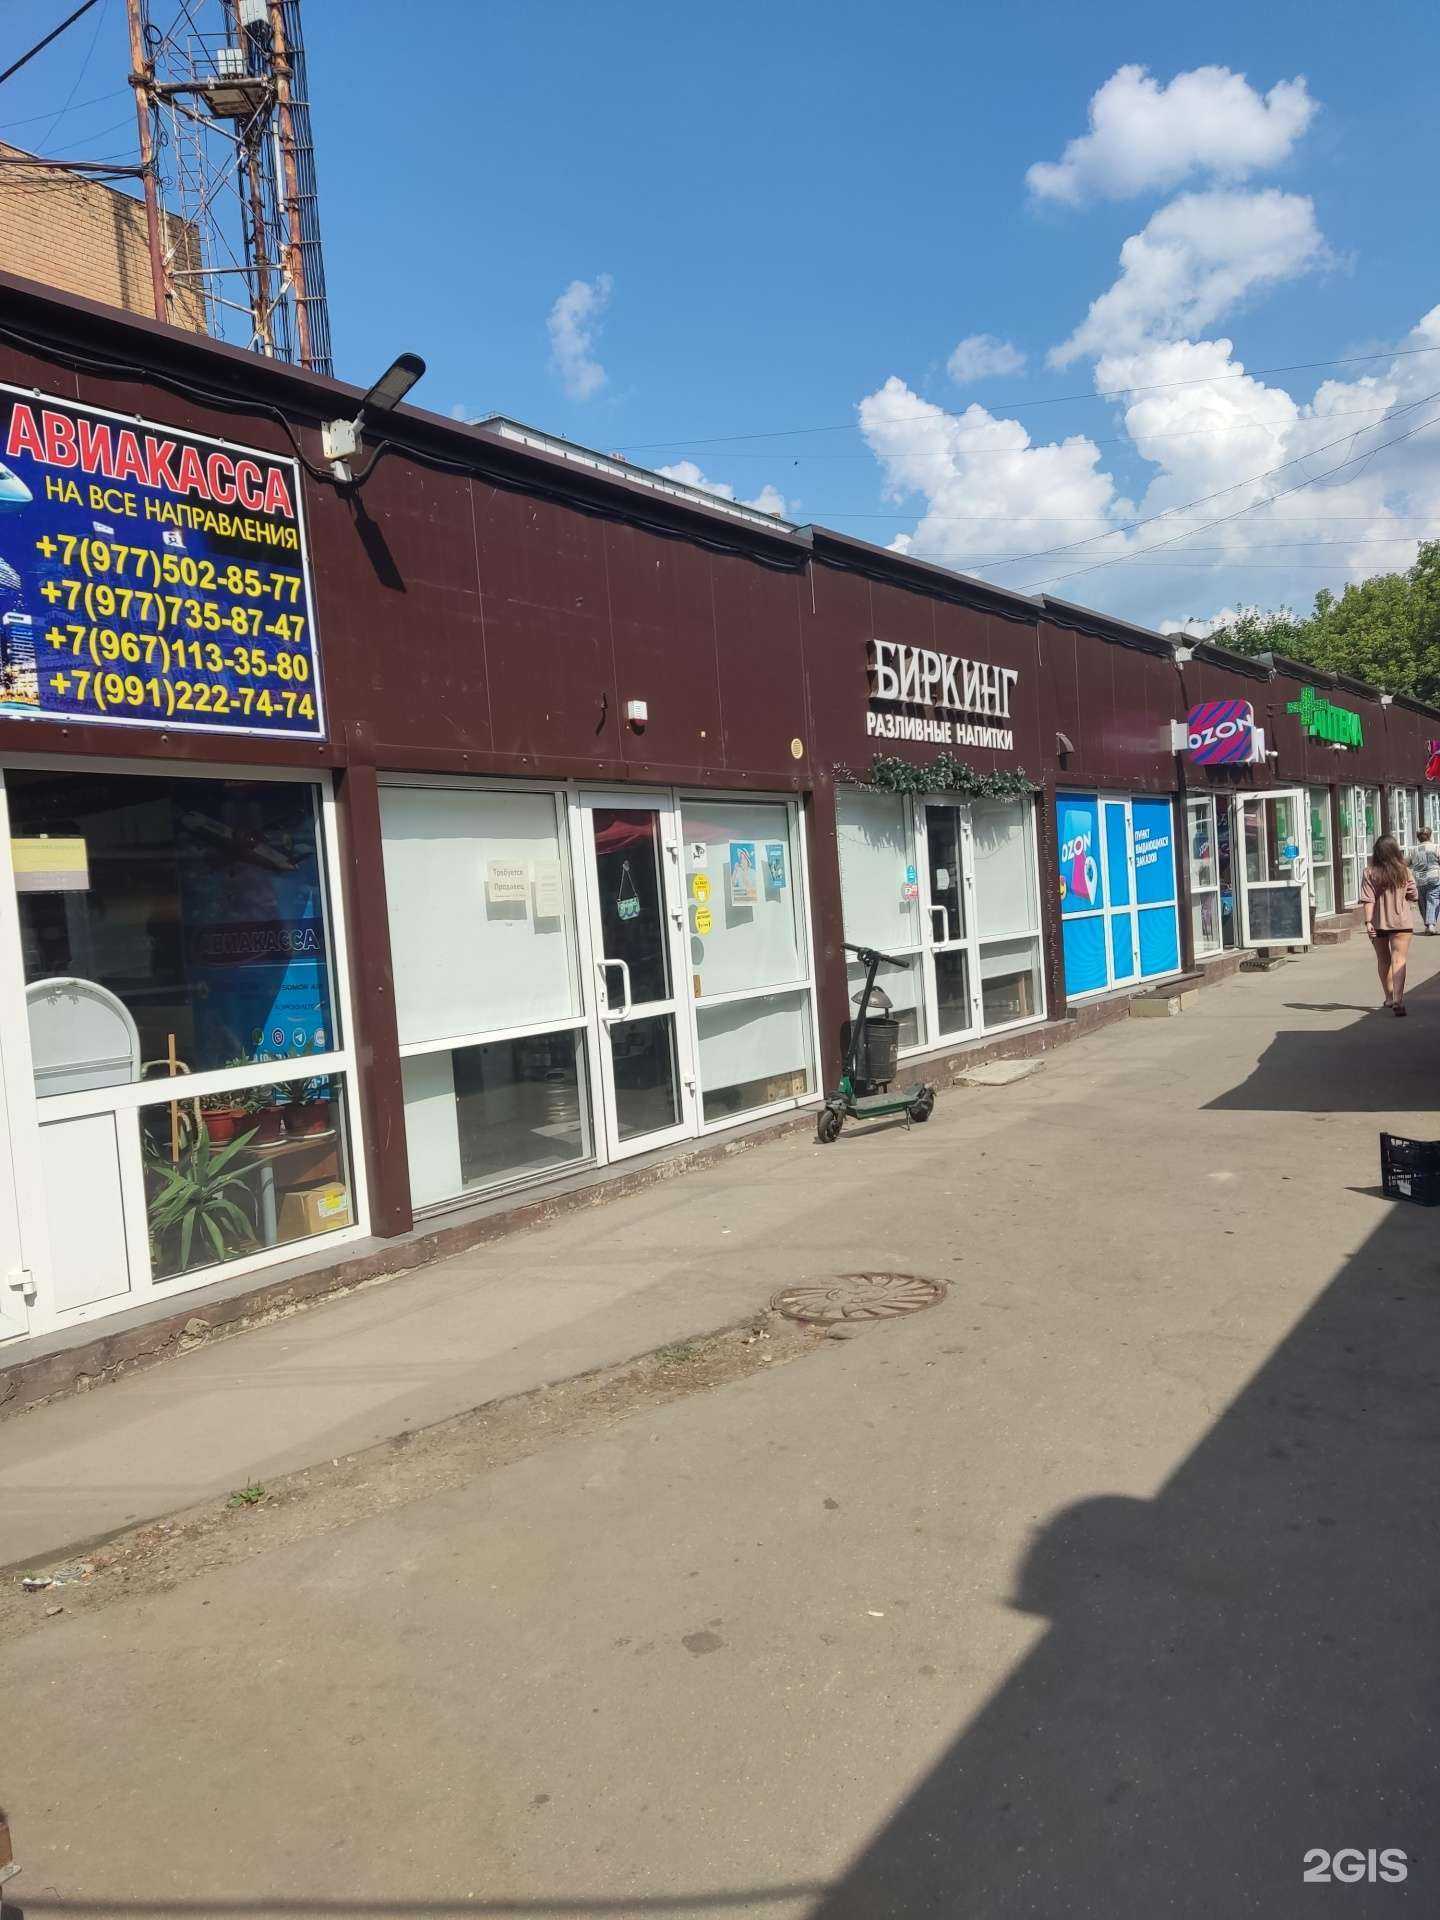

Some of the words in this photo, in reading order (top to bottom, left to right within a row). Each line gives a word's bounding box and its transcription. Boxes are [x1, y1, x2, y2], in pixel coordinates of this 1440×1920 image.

[6, 402, 295, 519] АВИАКАССА
[45, 475, 83, 508] НА
[88, 484, 138, 518] ВСЕ
[144, 496, 299, 550] НАПРАВЛЕНИЯ
[35, 533, 301, 604] +7(977)502-85-77
[40, 579, 305, 643] +7(977)735-87-47
[45, 624, 309, 683] +7(967)113-35-80
[868, 639, 1019, 718] БИРКИНГ
[49, 669, 315, 721] +7(991)222-74-74
[865, 711, 952, 744] РАЗЛИВНЫЕ
[956, 722, 1014, 751] НАПИТКИ
[1188, 714, 1255, 750] OZON
[1061, 830, 1092, 863] OZON
